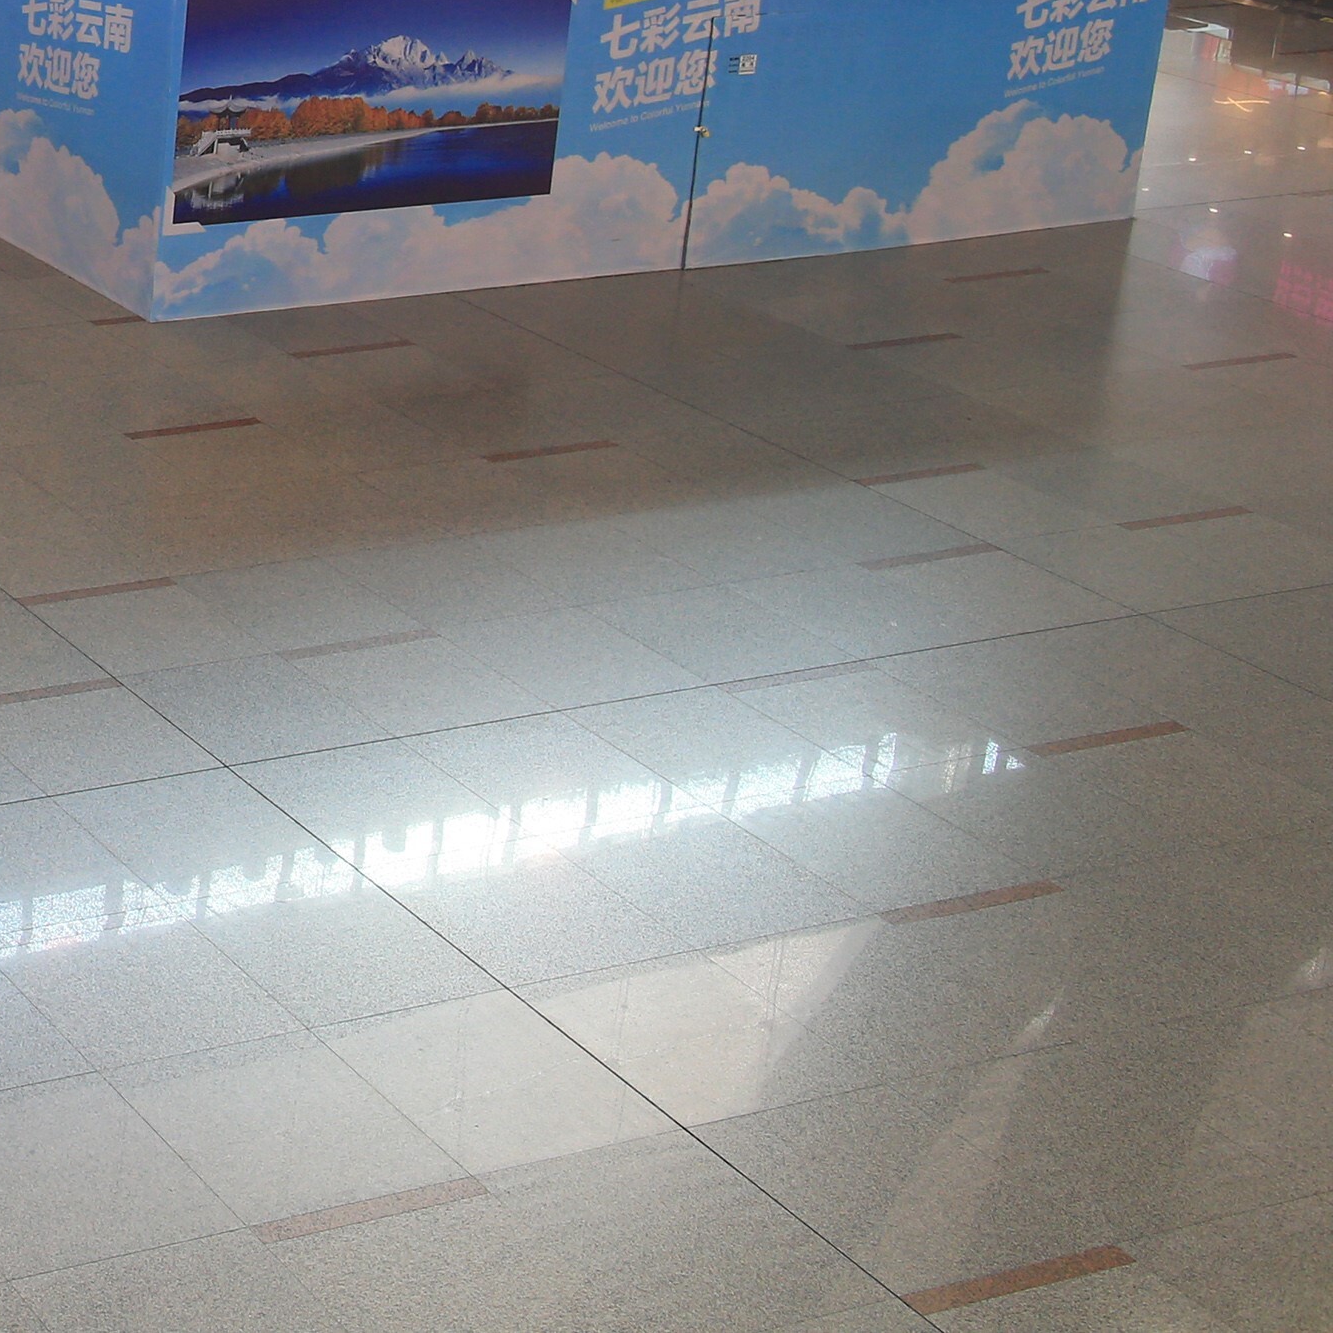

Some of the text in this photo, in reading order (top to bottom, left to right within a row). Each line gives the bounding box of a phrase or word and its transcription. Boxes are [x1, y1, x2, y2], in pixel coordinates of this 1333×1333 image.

[18, 42, 100, 99] 欢迎您
[1007, 19, 1114, 80] 欢迎您
[592, 49, 718, 114] 欢迎您
[590, 118, 633, 132] Welcome
[640, 106, 673, 121] Colorful
[676, 99, 710, 112] Yunnan
